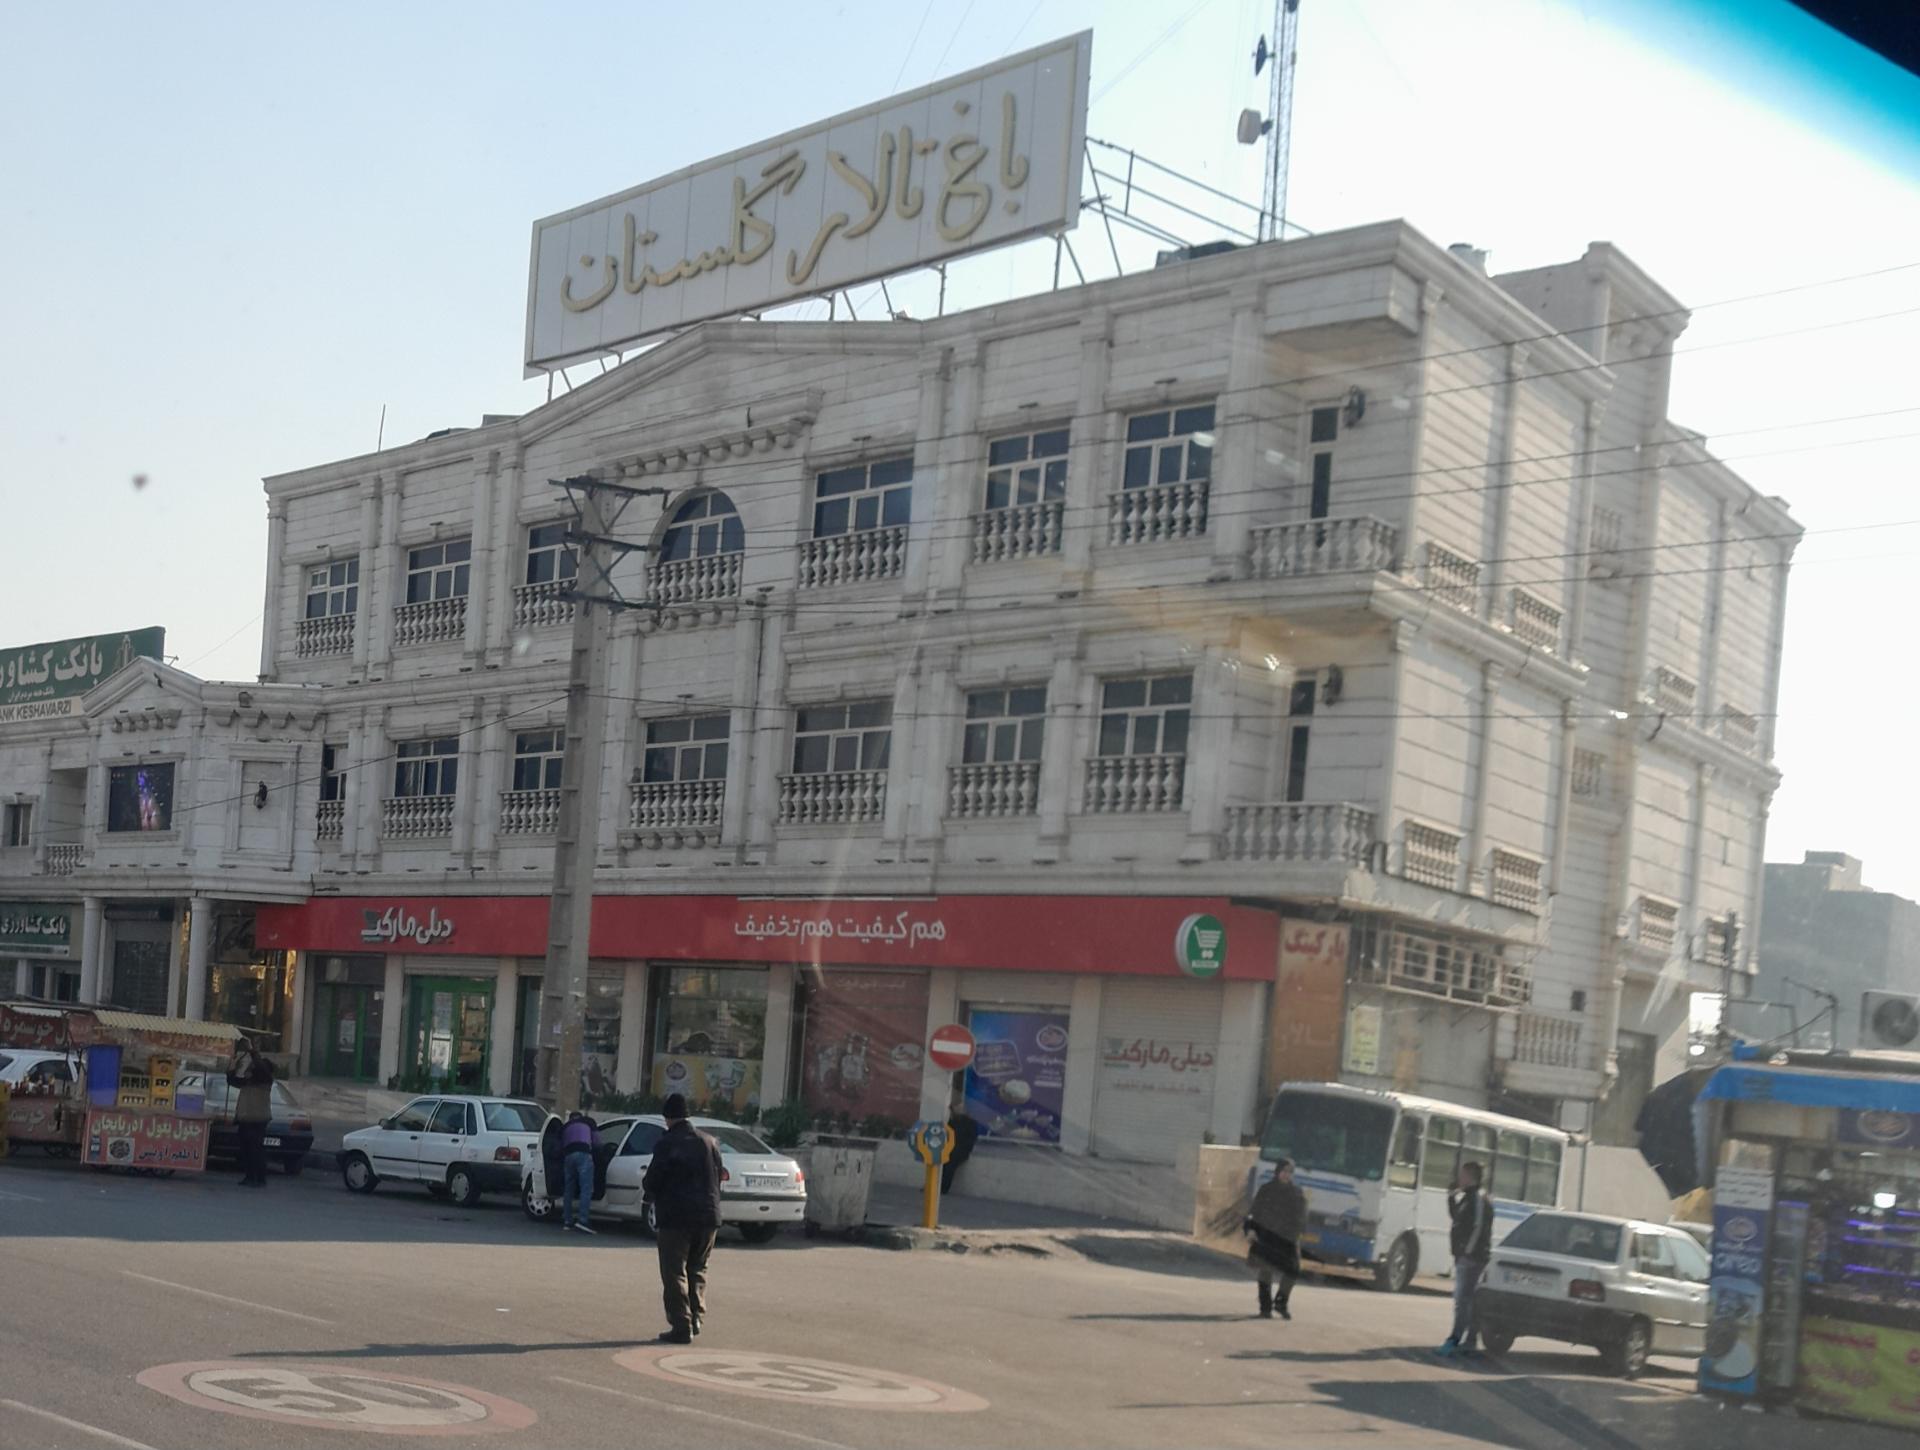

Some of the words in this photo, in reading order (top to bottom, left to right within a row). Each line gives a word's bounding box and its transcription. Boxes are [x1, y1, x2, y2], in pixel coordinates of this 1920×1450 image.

[935, 92, 1029, 242] باغ
[785, 125, 938, 286] تالار
[560, 150, 806, 313] گلستان
[55, 640, 103, 688] بانک
[16, 700, 72, 720] KESHAVARZI
[1, 914, 43, 934] کشاورزی
[42, 915, 66, 938] بانک
[734, 914, 801, 940] تخفیف
[800, 918, 835, 945] هم
[837, 911, 909, 945] کیفیت
[910, 914, 946, 949] هم
[674, 1360, 911, 1394] 50
[204, 1376, 463, 1414] 50
